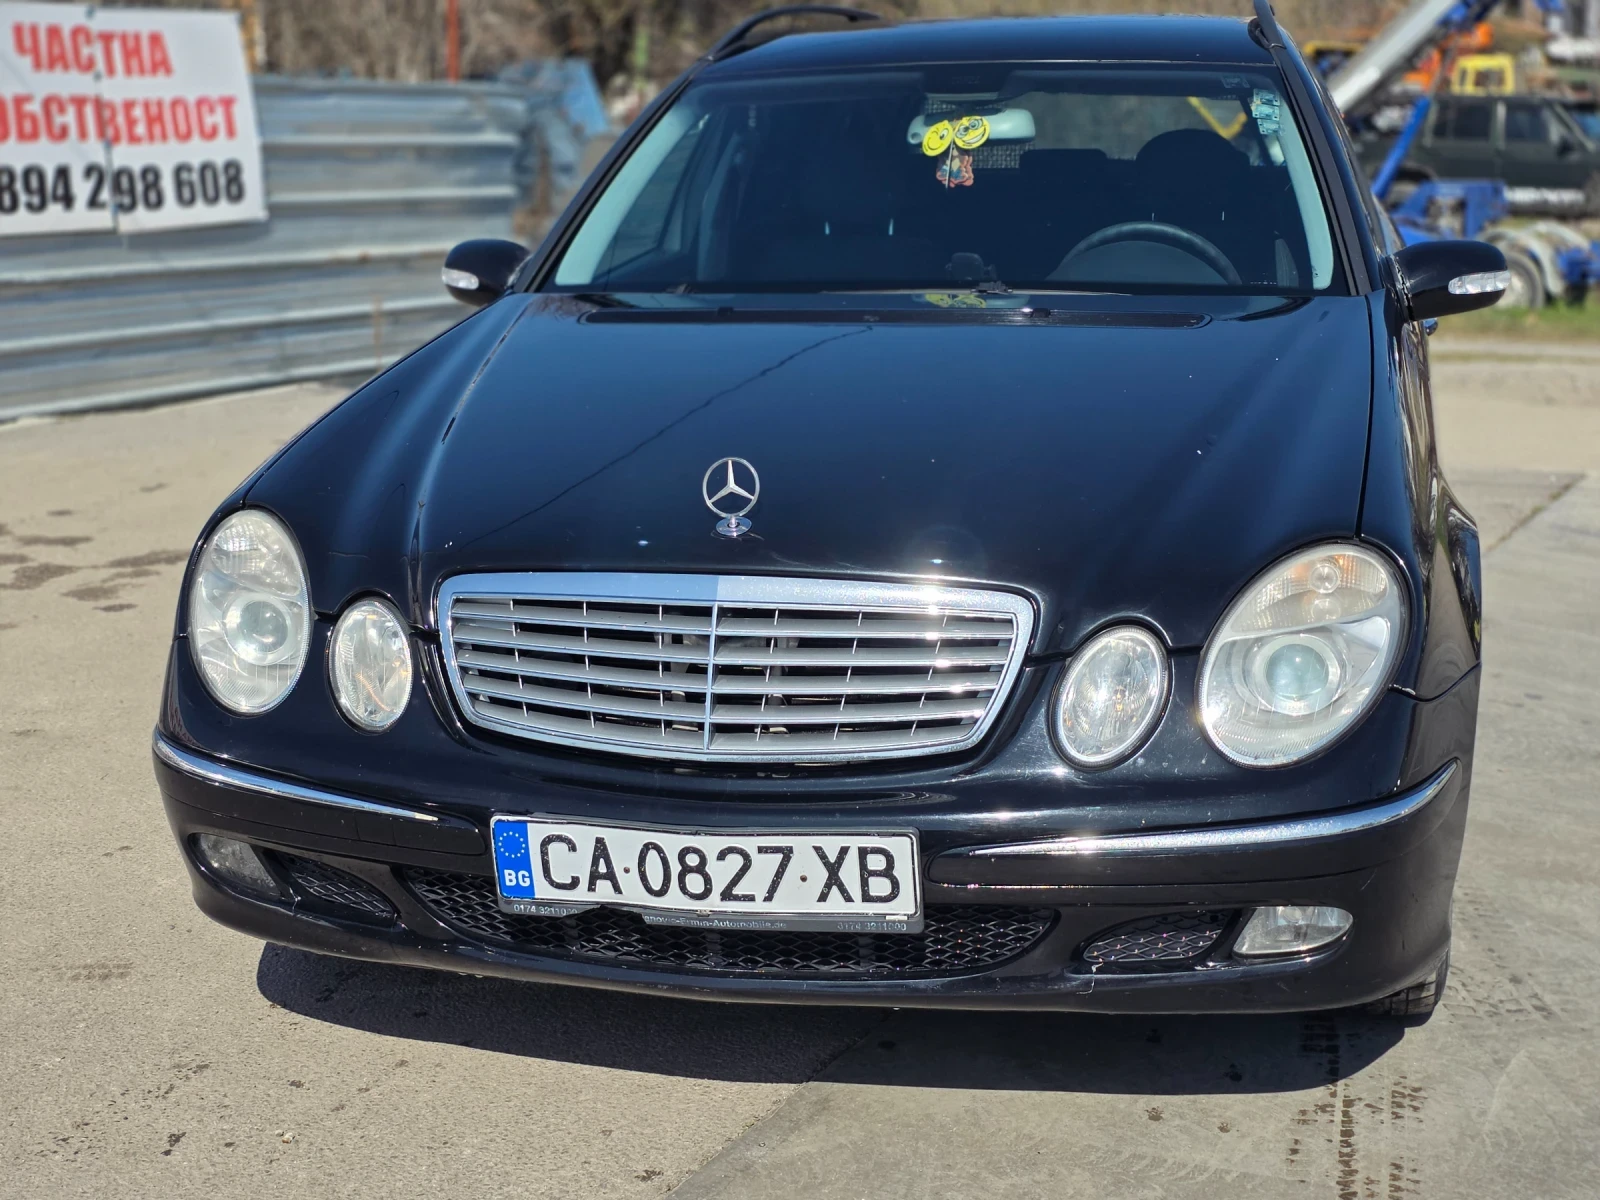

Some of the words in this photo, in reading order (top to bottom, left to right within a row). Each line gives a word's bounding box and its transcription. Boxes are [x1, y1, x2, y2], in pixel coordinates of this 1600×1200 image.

[12, 21, 174, 78] ЧАСТНА
[83, 161, 164, 213] 298
[173, 159, 245, 208] 608
[504, 869, 530, 887] BG
[638, 841, 794, 902] 0827
[513, 904, 537, 913] 0174
